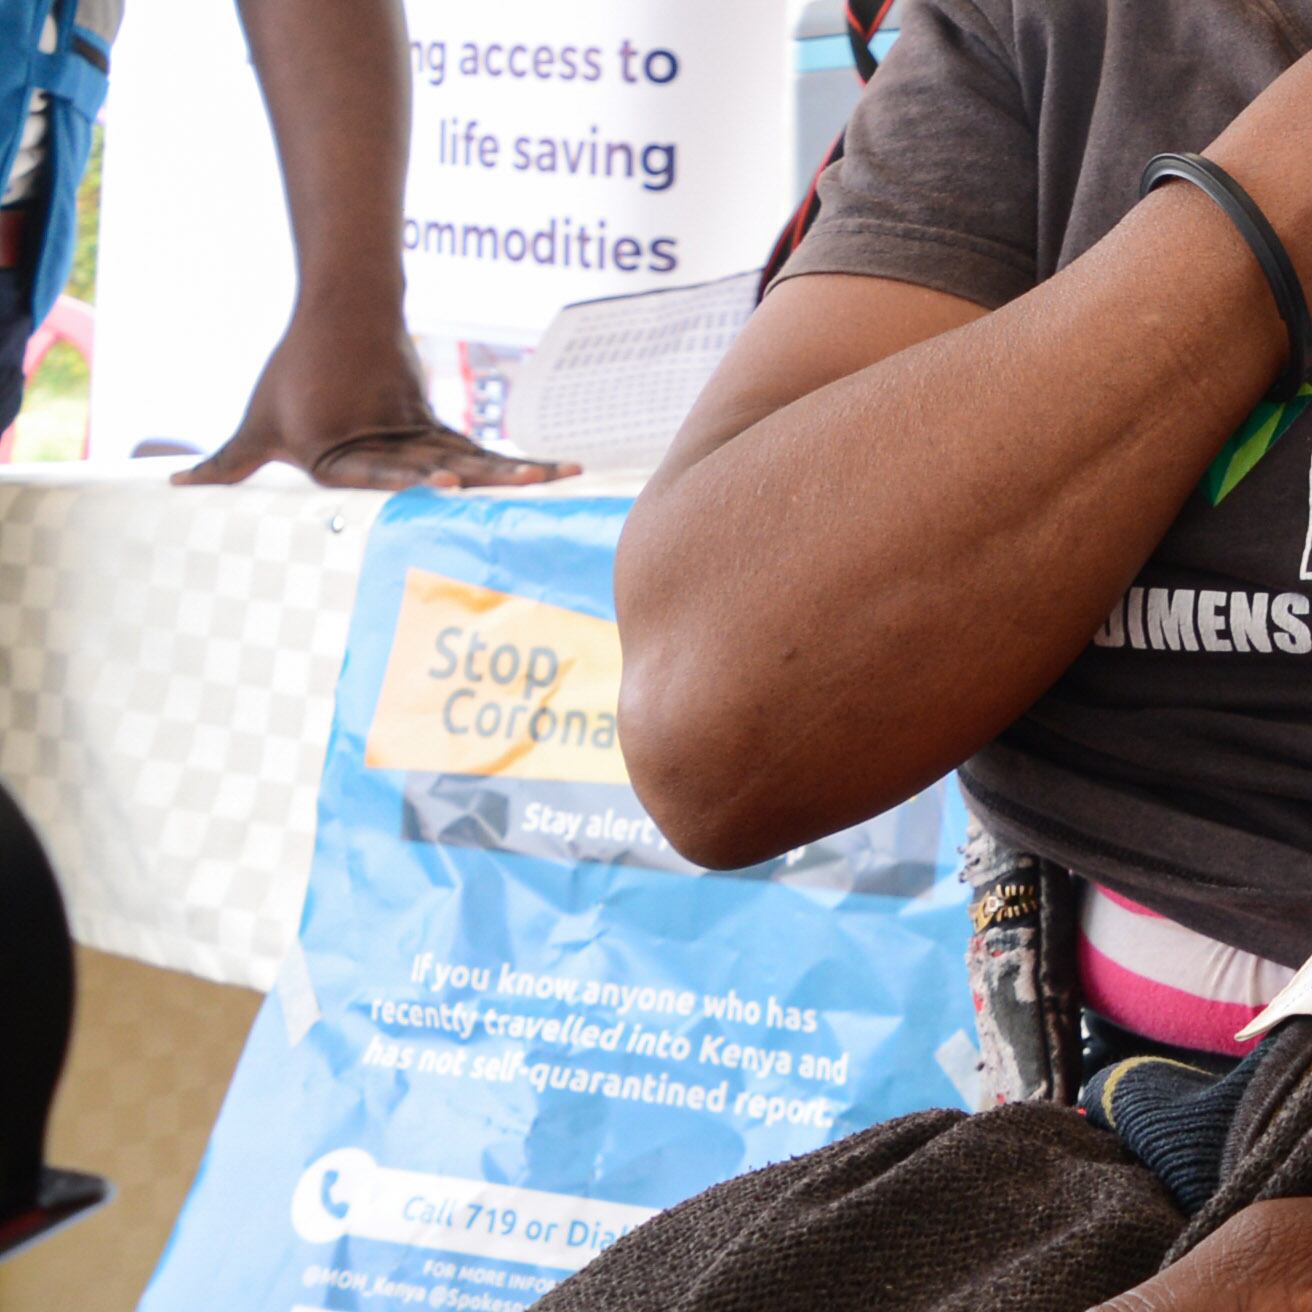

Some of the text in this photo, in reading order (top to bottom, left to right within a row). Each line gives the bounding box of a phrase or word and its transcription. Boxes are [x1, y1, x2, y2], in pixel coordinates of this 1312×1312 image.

[409, 39, 680, 86] ng access to
[439, 119, 678, 191] life saving
[403, 217, 679, 274] ommodities
[429, 626, 558, 700] Stop
[443, 688, 617, 749] Corona
[520, 801, 655, 846] Stay alert
[411, 953, 818, 1034] If you know anyone who has
[370, 999, 849, 1086] recently travelled into Kenya and
[362, 1035, 835, 1128] has not self-quarantined report.
[403, 1195, 456, 1228] Call
[464, 1202, 517, 1237] 719
[525, 1218, 557, 1243] or
[422, 1259, 457, 1280] FOR
[458, 1264, 506, 1288] MORE
